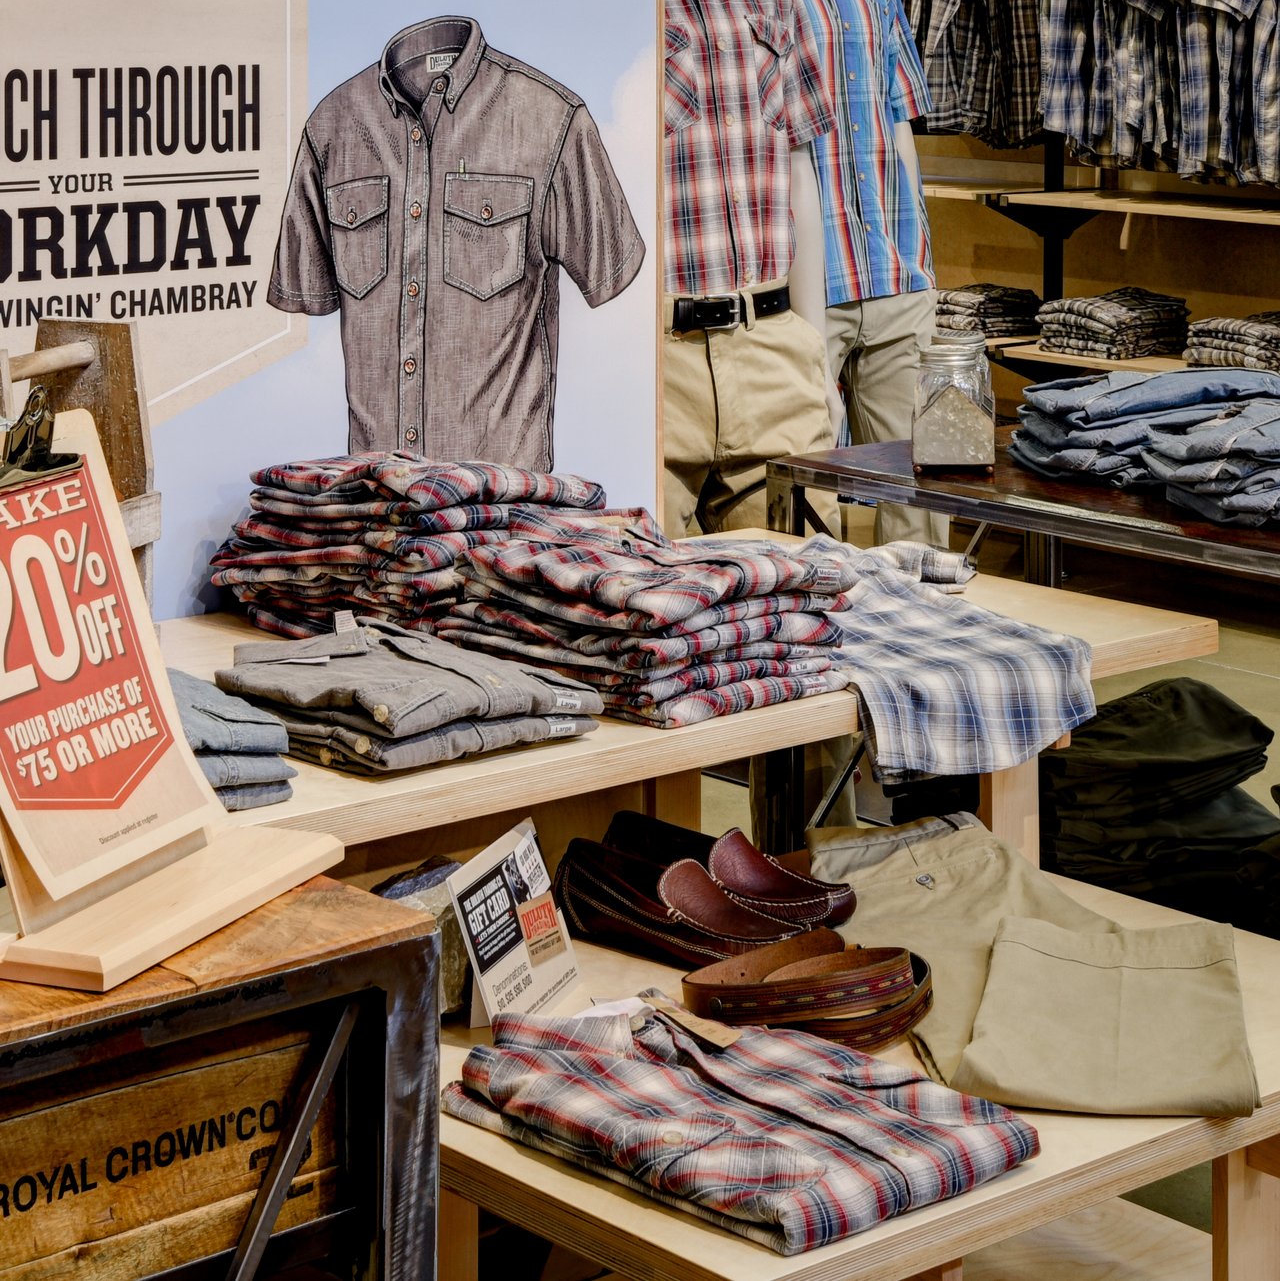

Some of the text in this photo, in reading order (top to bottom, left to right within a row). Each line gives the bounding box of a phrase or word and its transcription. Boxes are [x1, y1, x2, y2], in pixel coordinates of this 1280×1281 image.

[71, 64, 261, 161] THROUGH
[47, 173, 114, 194] YOUR
[110, 280, 258, 319] CHAMBRAY
[76, 594, 126, 666] OFF
[4, 676, 143, 754] YOUR PURCHASE OF
[560, 700, 578, 709] Large
[16, 706, 158, 787] $75 OR MORE
[98, 829, 120, 845] Discount
[468, 887, 510, 936] GIFT CARD
[521, 901, 557, 941] DULUTH
